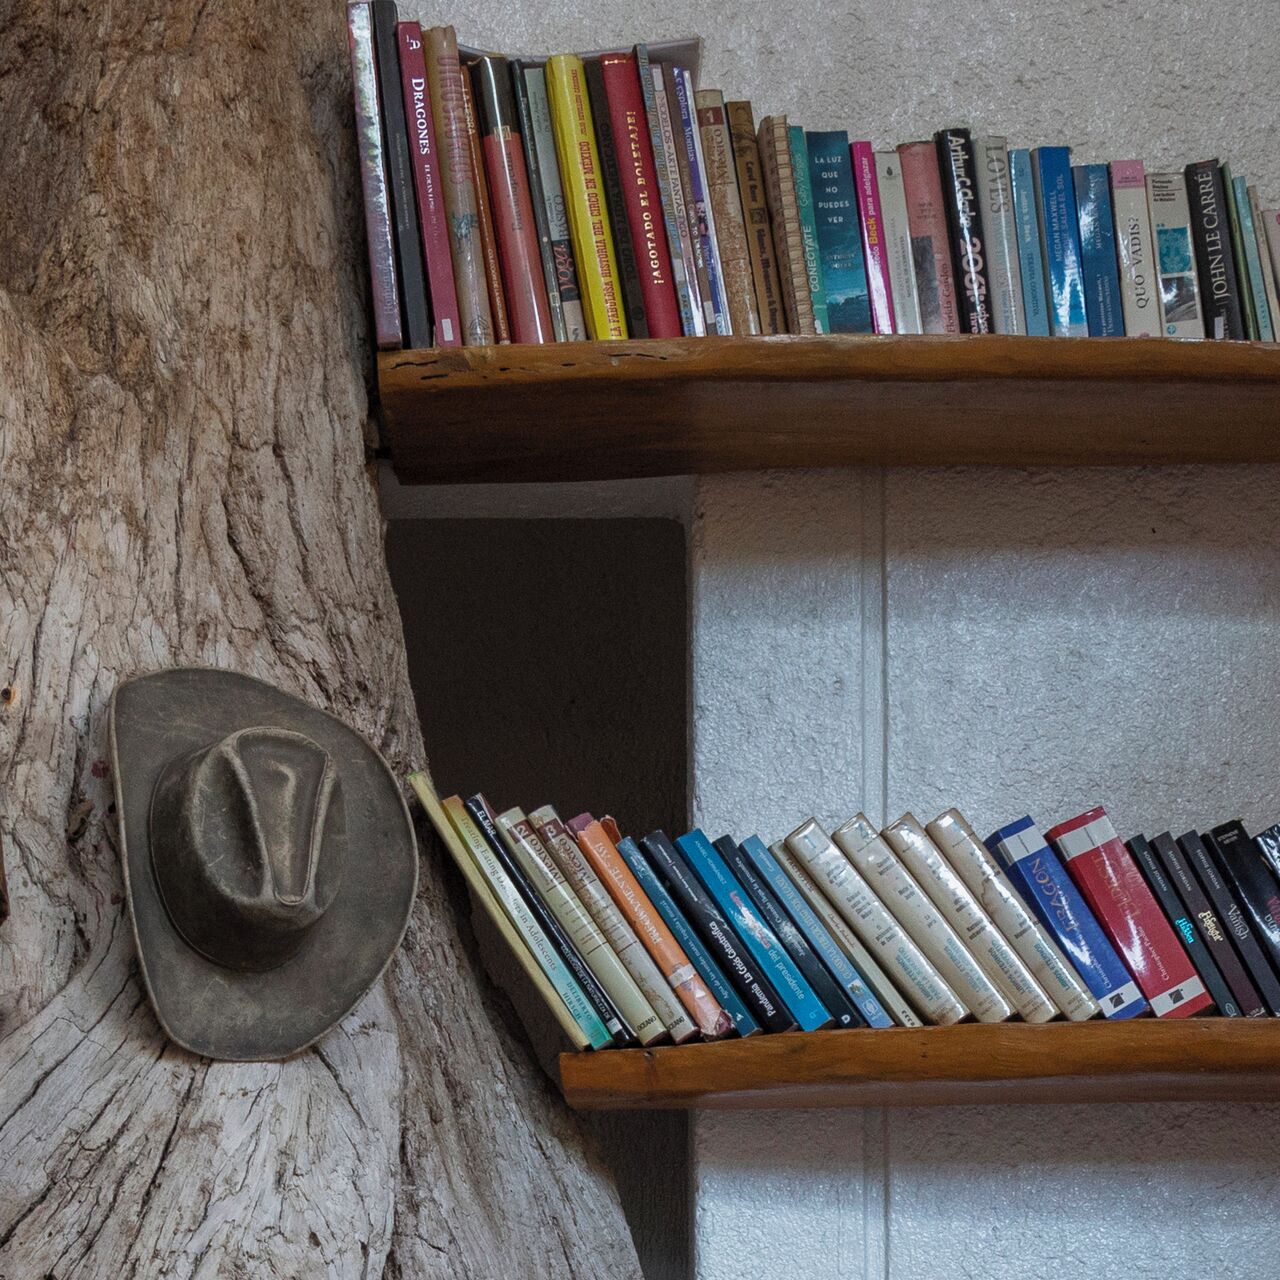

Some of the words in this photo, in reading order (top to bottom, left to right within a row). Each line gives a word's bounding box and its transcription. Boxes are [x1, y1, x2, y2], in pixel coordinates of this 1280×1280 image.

[411, 78, 431, 155] DRAGONES
[682, 125, 696, 161] Momias
[827, 156, 842, 164] LUZ
[948, 134, 971, 177] Arthur
[584, 176, 596, 189] EN
[821, 171, 838, 179] QUE
[825, 186, 838, 194] NO
[859, 156, 872, 195] adelgazar
[587, 191, 601, 217] CIRCO
[638, 190, 650, 207] EL
[818, 201, 850, 209] PUEDES
[865, 197, 875, 215] para
[1049, 190, 1059, 230] MAXWELL
[1195, 171, 1218, 229] CARRÉ
[591, 219, 604, 236] DEL
[827, 216, 843, 224] VER
[867, 217, 878, 244] Beck
[595, 238, 611, 278] HISTORIA
[642, 211, 663, 284] ¡AGOTADO
[1053, 232, 1062, 261] MEGAN
[1128, 216, 1142, 266] VADIS?
[1205, 230, 1221, 251] LE
[940, 262, 951, 297] Garden
[1134, 274, 1148, 308] QUO
[1208, 254, 1229, 299] JOHN
[602, 281, 619, 323] FABULOSA
[944, 300, 955, 332] Florida
[609, 326, 621, 337] LA
[1142, 849, 1157, 870] SOPHIE
[1152, 868, 1169, 892] JORDAN
[1167, 849, 1182, 870] SOPHIE
[1177, 869, 1193, 892] JORDAN
[1194, 848, 1210, 869] SOPHIE
[1205, 867, 1222, 890] JORDAN
[478, 848, 499, 876] Eating
[517, 913, 529, 924] in
[523, 923, 558, 972] Adolescents
[1027, 855, 1077, 933] ERAGON
[706, 920, 737, 959] Catastrófica
[731, 955, 747, 975] Crisis
[741, 971, 753, 983] La
[767, 947, 781, 962] del
[775, 960, 806, 1001] presidente
[1147, 945, 1170, 981] Christopher
[712, 978, 721, 987] de
[716, 984, 729, 999] Agua
[748, 982, 776, 1017] Pandemia
